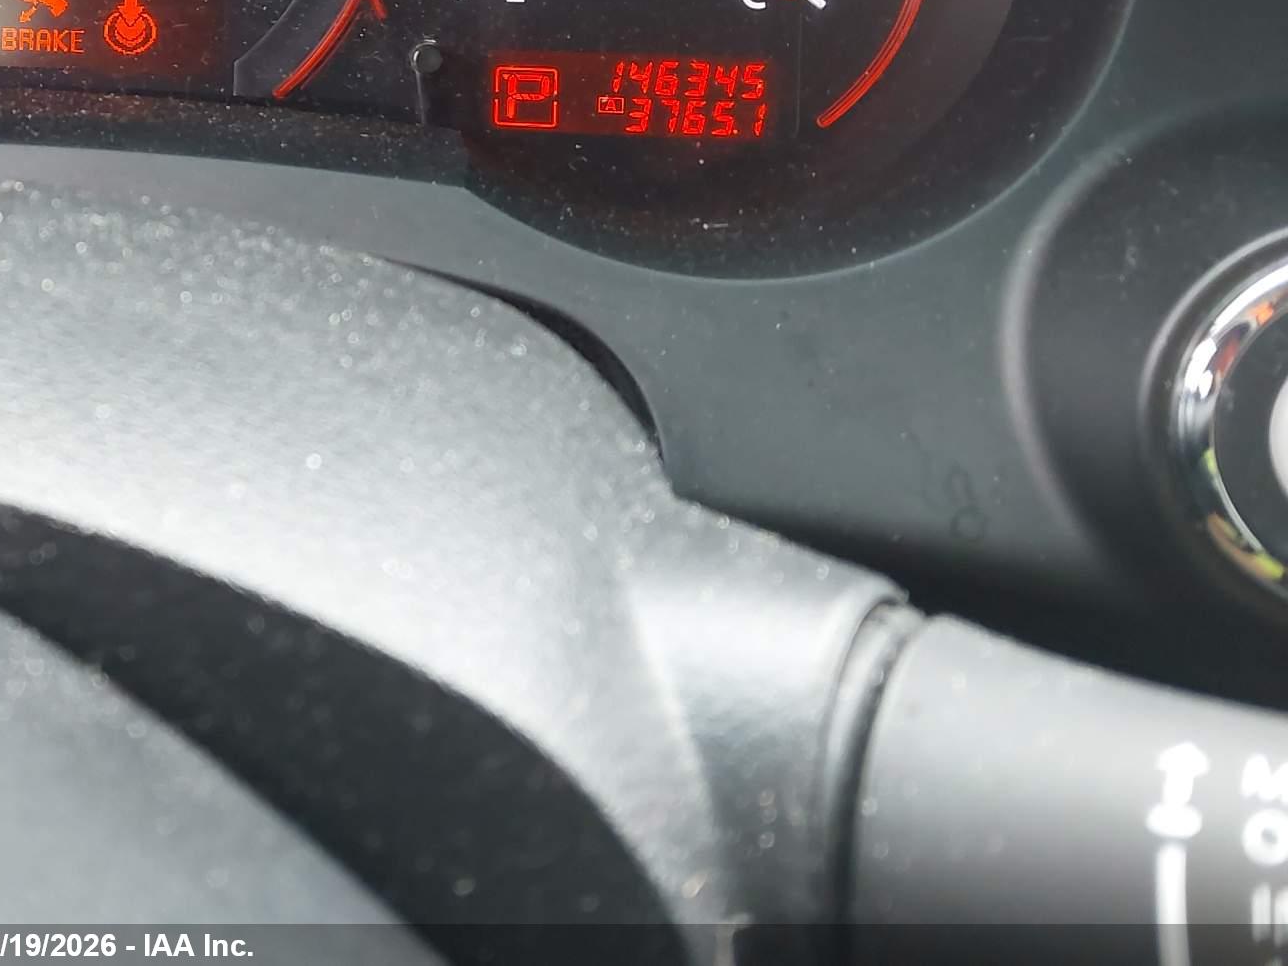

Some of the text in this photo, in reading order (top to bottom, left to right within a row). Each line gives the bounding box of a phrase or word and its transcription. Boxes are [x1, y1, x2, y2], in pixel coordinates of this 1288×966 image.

[0, 27, 86, 53] BRAKE
[503, 73, 550, 118] P
[611, 60, 765, 99] 146345
[625, 97, 767, 136] 3765.1
